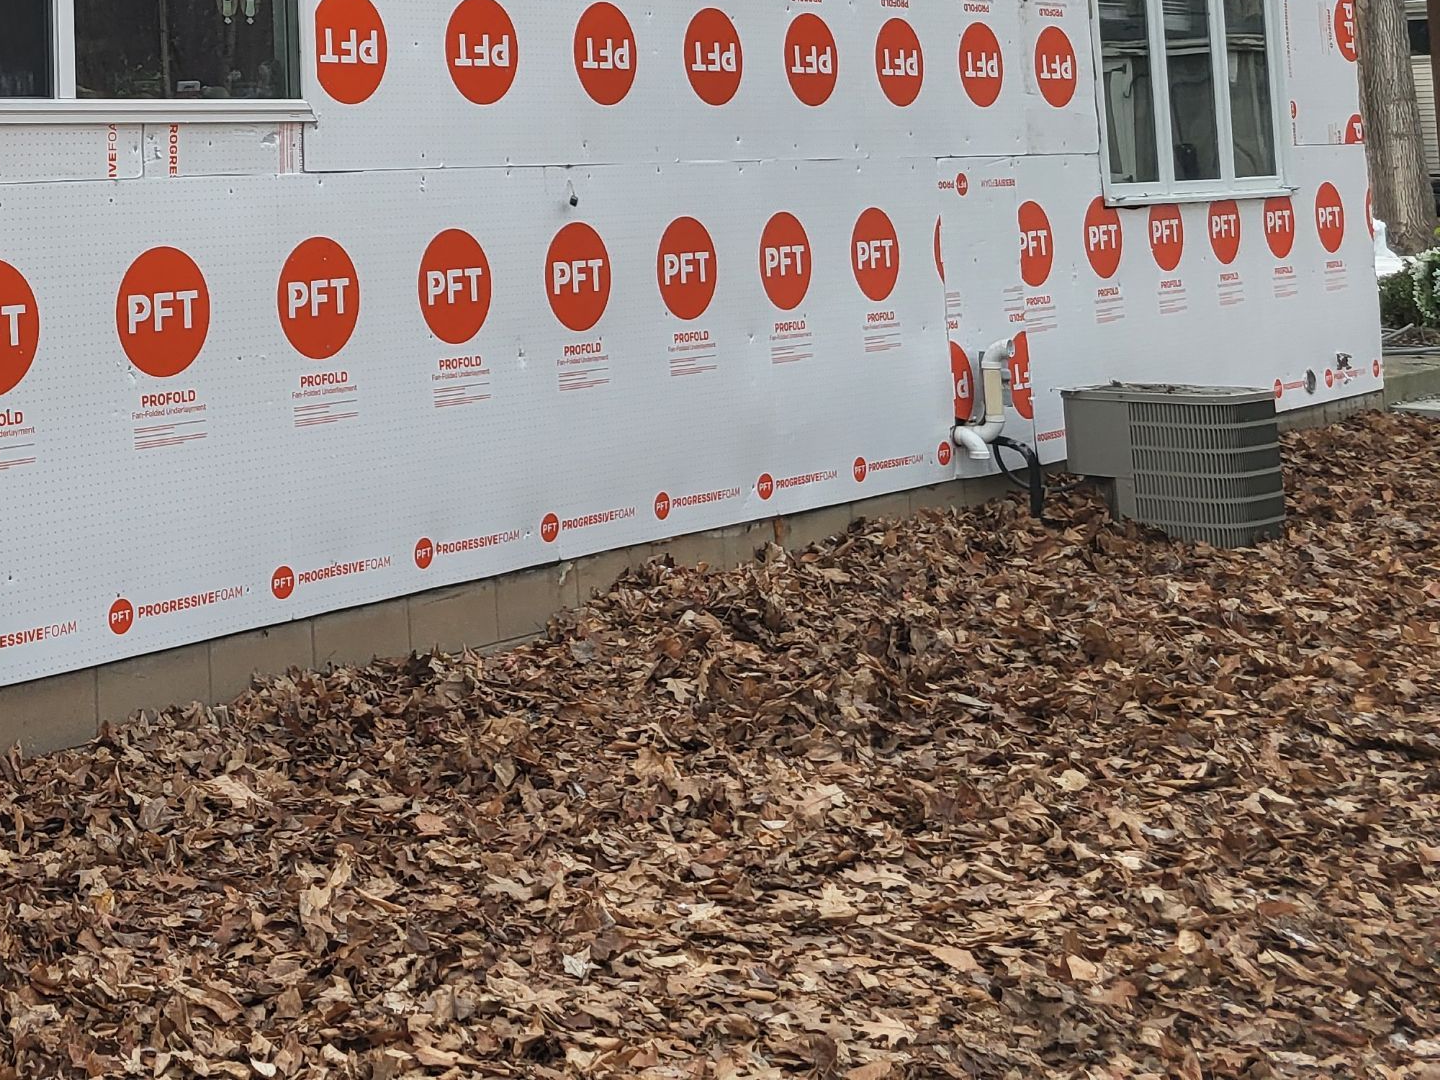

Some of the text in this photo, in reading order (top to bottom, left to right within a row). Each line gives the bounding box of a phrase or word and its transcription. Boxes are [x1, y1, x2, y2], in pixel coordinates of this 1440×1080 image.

[320, 28, 379, 65] PFT
[455, 34, 510, 67] PFT
[583, 38, 630, 70] PFT
[691, 42, 737, 72] PFT
[791, 46, 832, 75] PFT
[881, 49, 919, 77] PFT
[964, 52, 1000, 78] PFT
[1040, 55, 1072, 80] PFT
[1152, 219, 1178, 244] PFT
[1211, 214, 1236, 238] PFT
[1266, 210, 1290, 233] PFT
[1318, 206, 1341, 229] PFT
[1088, 224, 1118, 251] PFT
[664, 251, 709, 285] PFT
[765, 245, 805, 277] PFT
[856, 239, 893, 270] PFT
[427, 267, 482, 305] PFT
[553, 259, 603, 294] PFT
[128, 290, 199, 334] PFT
[288, 278, 350, 319] PFT
[774, 320, 806, 333] PROFOLD
[866, 311, 895, 323] PROFOLD
[563, 342, 602, 356] PROFOLD
[673, 330, 709, 344] PROFOLD
[438, 355, 483, 371] PROFOLD
[300, 371, 349, 388] PROFOLD
[140, 389, 197, 407] PROFOLD
[775, 471, 838, 488] PROGRESSIVEFOAM
[655, 487, 741, 512] PFT PROGRESSIVEFOAM
[542, 506, 636, 534] PFT PROGRESSIVEFOAM
[416, 529, 520, 560] PFT PROGRESSIVEFOAM
[273, 557, 391, 589] PFT PROGRESSIVEFOAM
[111, 586, 243, 623] PFT PROGRESSIVEFOAM
